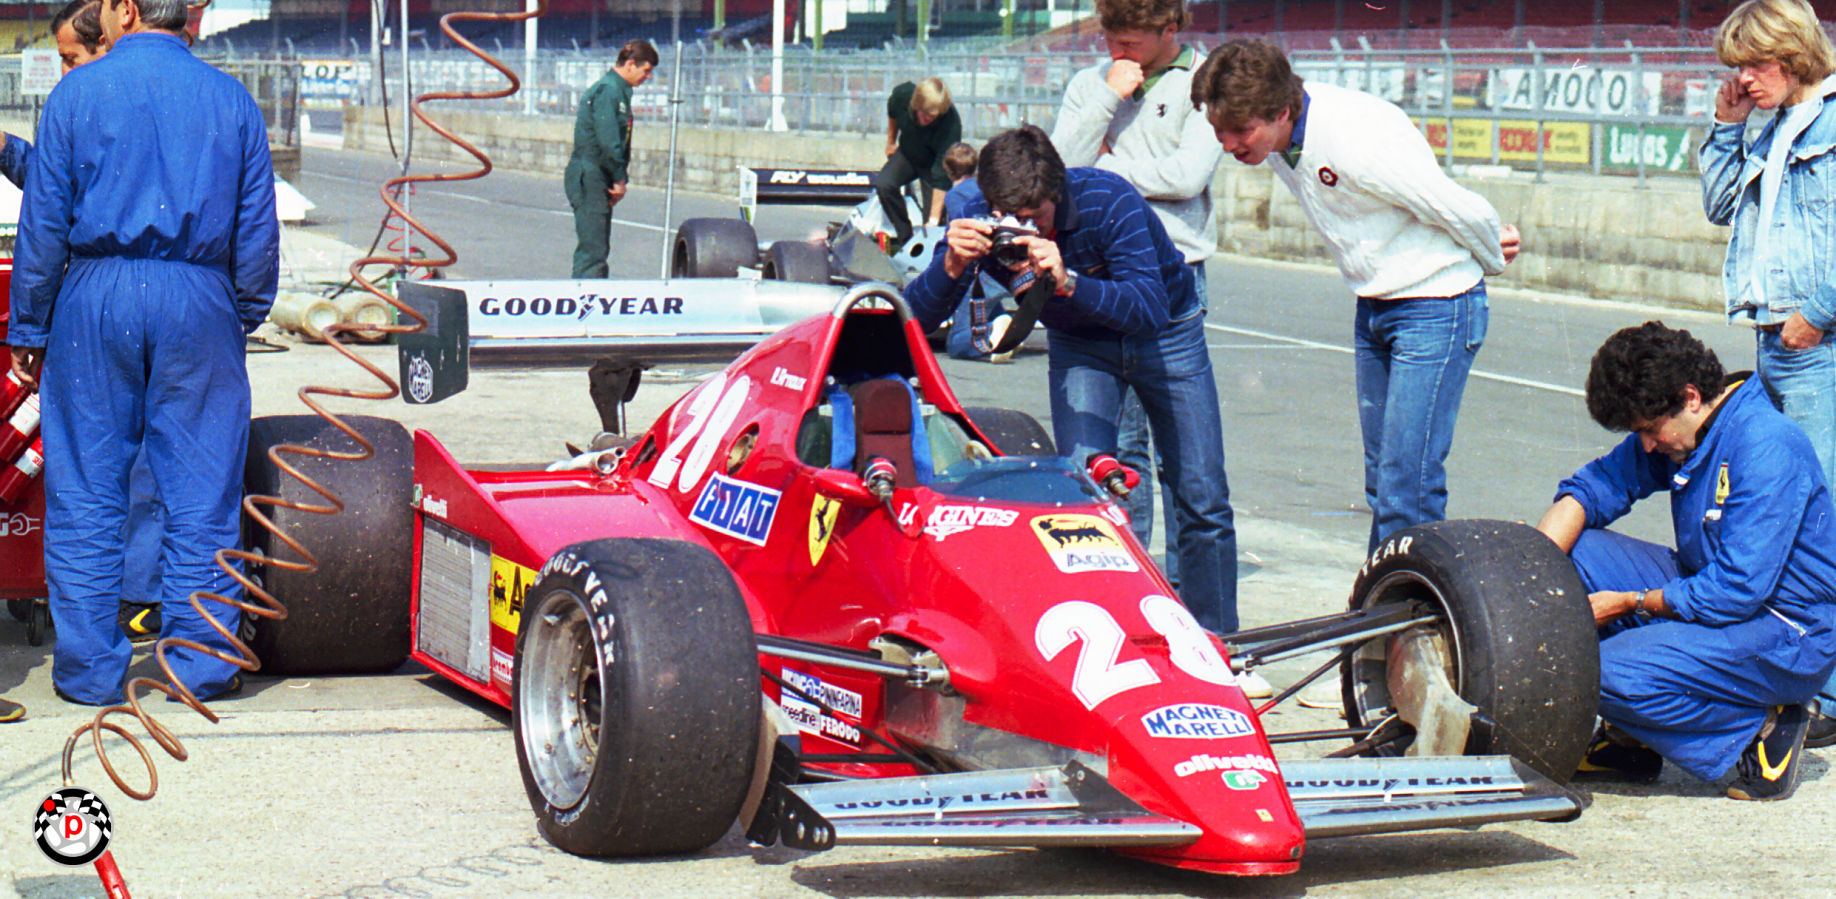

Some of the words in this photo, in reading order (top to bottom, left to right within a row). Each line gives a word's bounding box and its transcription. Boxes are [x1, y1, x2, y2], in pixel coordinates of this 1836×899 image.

[1513, 72, 1627, 111] AMOCO
[1610, 126, 1668, 167] Lucas
[700, 484, 773, 532] FIAT
[898, 502, 1020, 528] LOGINES
[1066, 552, 1130, 568] Agip
[1034, 594, 1240, 712] 28
[820, 714, 861, 743] FERODO
